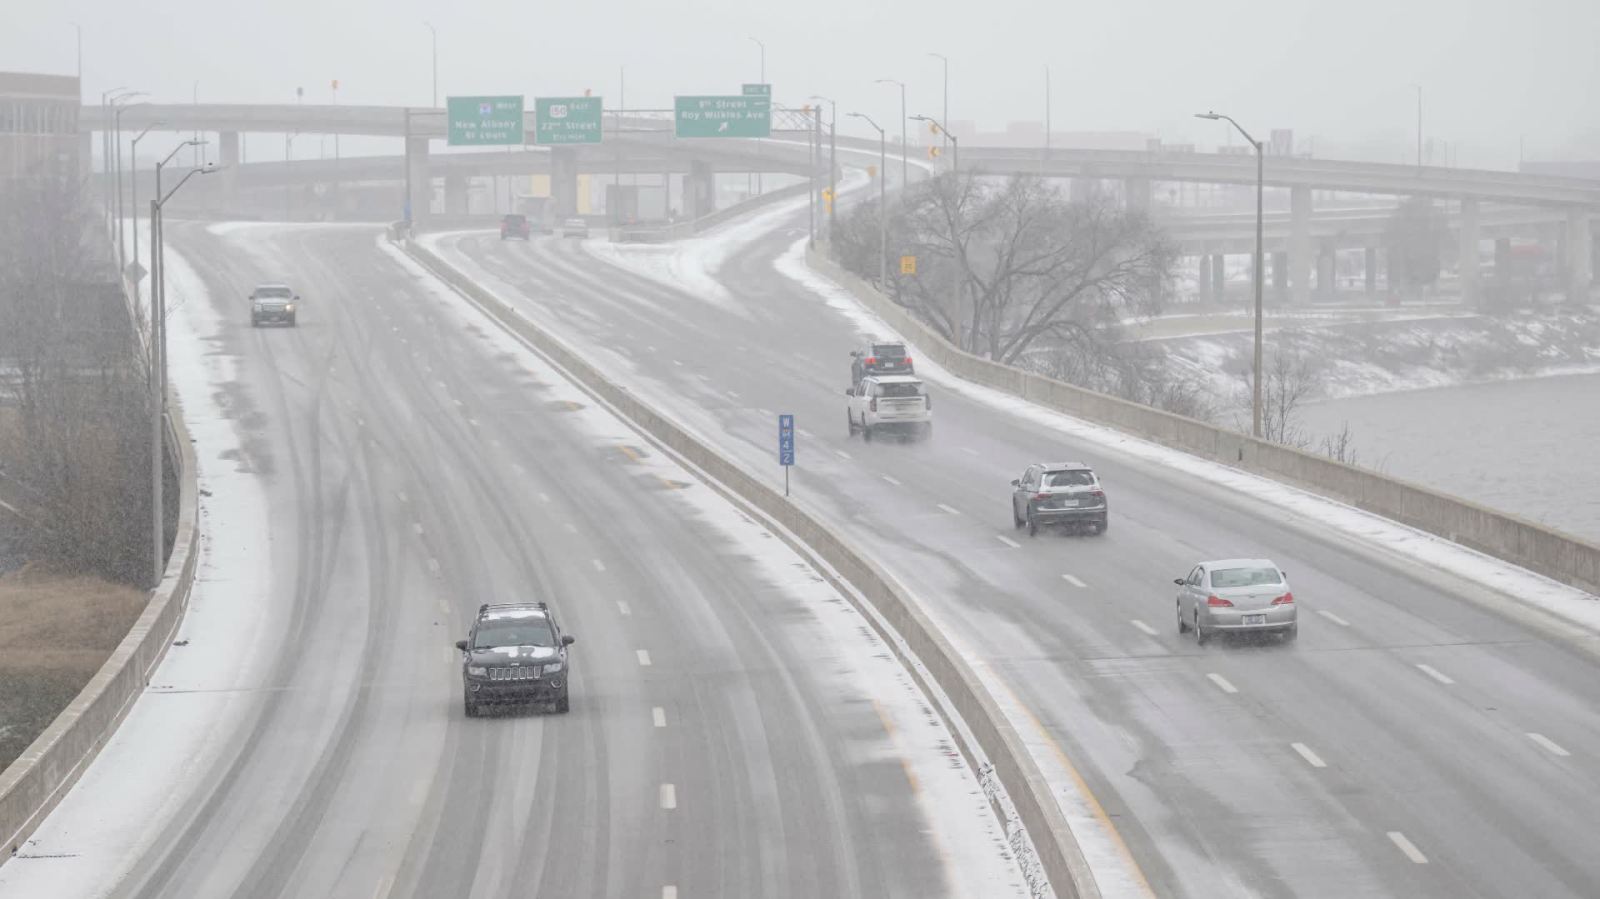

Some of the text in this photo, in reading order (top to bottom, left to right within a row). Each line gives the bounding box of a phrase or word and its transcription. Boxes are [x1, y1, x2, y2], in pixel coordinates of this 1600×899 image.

[716, 100, 747, 109] Street
[681, 111, 765, 121] Roy Wilkins Ave
[455, 121, 517, 131] New Albany
[565, 121, 597, 130] Street
[783, 417, 790, 428] W
[783, 453, 790, 464] 2
